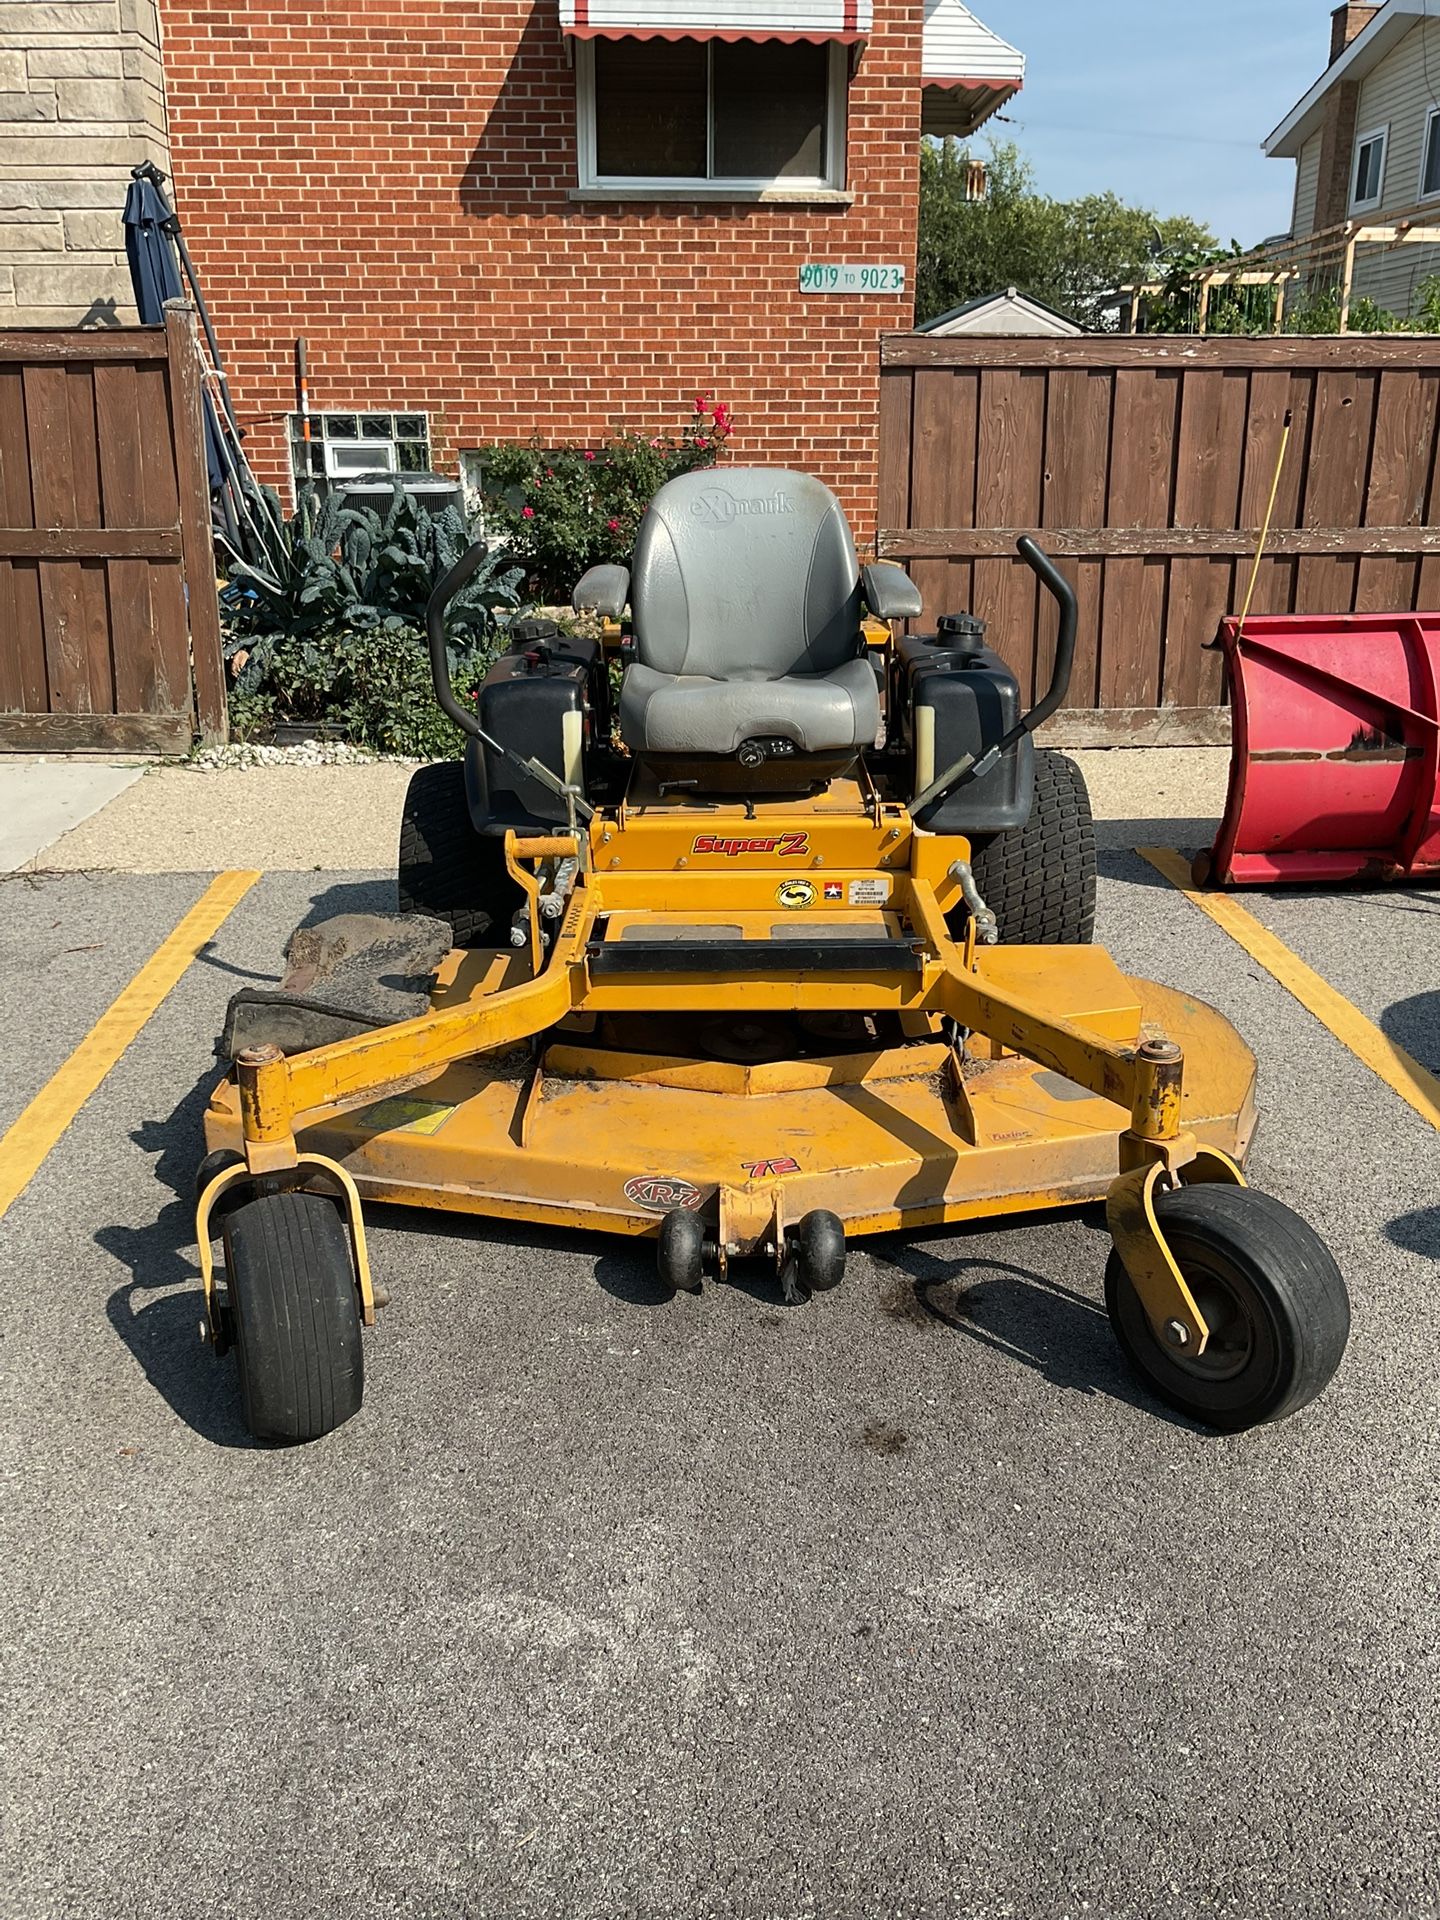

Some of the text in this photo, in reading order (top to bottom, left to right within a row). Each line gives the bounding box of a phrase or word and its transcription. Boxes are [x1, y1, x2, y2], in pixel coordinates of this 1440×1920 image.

[805, 267, 899, 289] 9019 TO 9023
[741, 1157, 801, 1178] 72
[627, 1181, 700, 1207] XR-7
